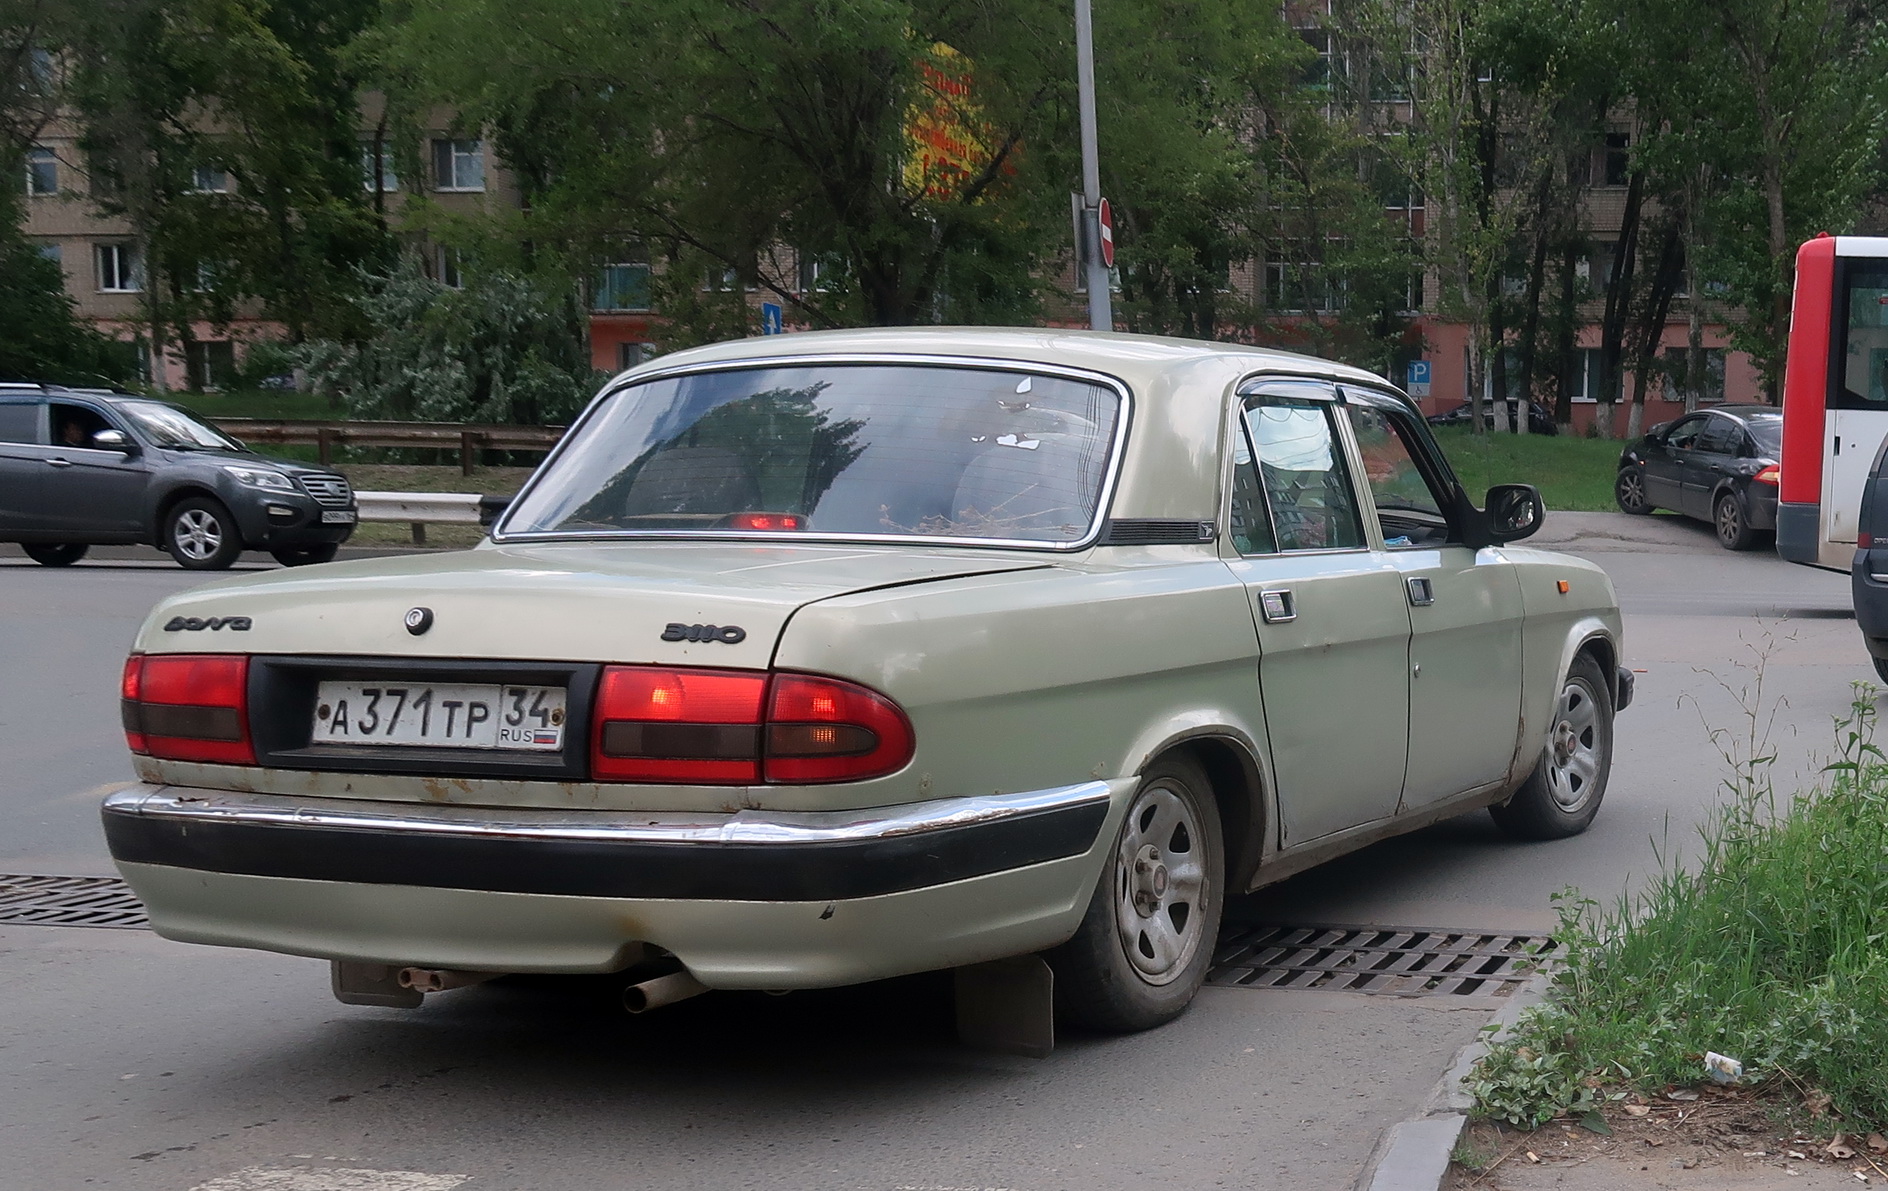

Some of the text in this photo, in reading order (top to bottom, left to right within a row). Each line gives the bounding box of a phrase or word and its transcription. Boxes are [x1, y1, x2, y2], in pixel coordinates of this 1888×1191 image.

[1414, 363, 1427, 381] P
[660, 623, 746, 644] 3110
[505, 689, 550, 728] 34
[500, 728, 533, 743] RUS
